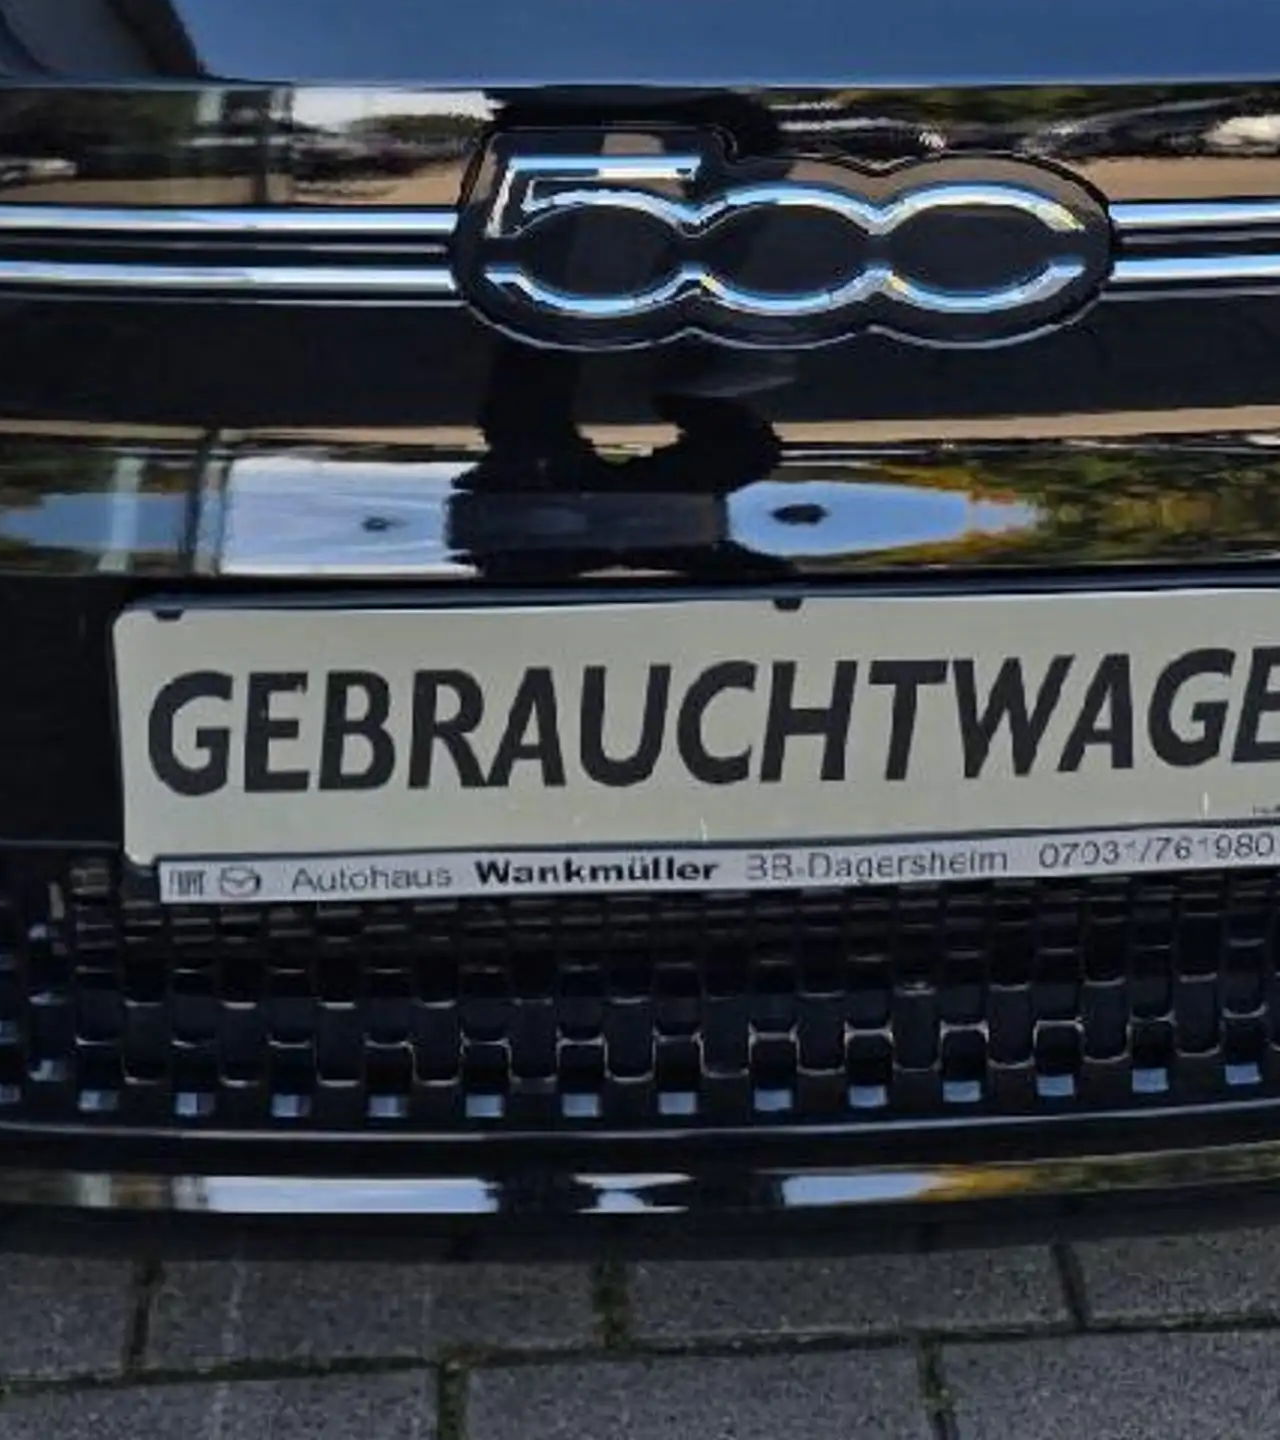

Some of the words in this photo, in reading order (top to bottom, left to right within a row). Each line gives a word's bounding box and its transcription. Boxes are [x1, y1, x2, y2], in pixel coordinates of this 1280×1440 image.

[484, 154, 1087, 316] 500
[291, 864, 453, 893] Autohaus
[474, 855, 720, 885] Wankmüller
